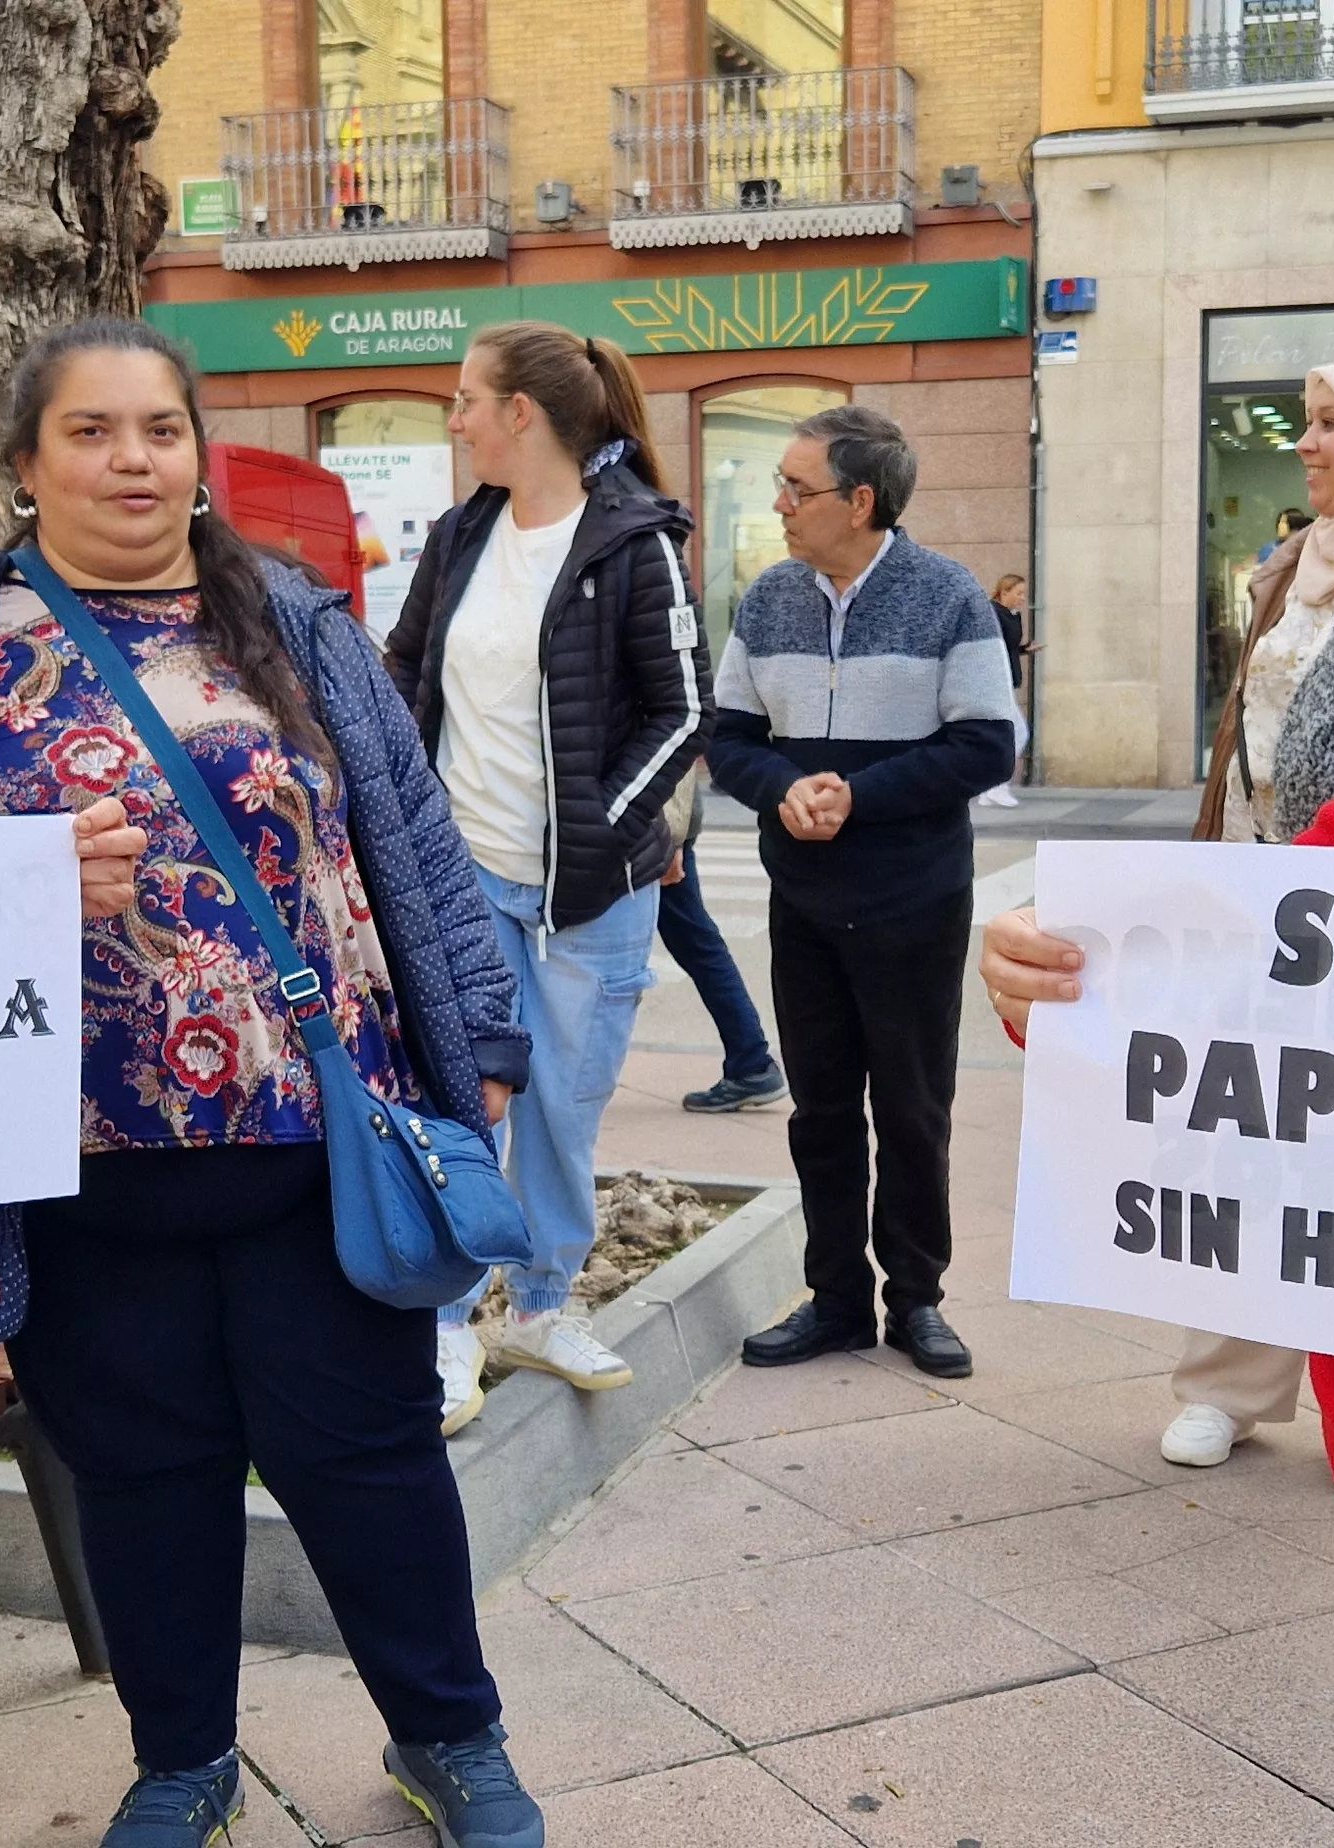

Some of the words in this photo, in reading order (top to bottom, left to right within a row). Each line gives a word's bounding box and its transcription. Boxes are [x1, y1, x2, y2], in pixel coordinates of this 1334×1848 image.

[329, 311, 387, 335] CAJA
[391, 307, 468, 331] RURAL
[346, 339, 370, 355] DE
[375, 332, 454, 354] ARAGÓN
[392, 455, 411, 465] UN
[376, 469, 392, 480] SE
[1113, 1180, 1241, 1274] SIN
